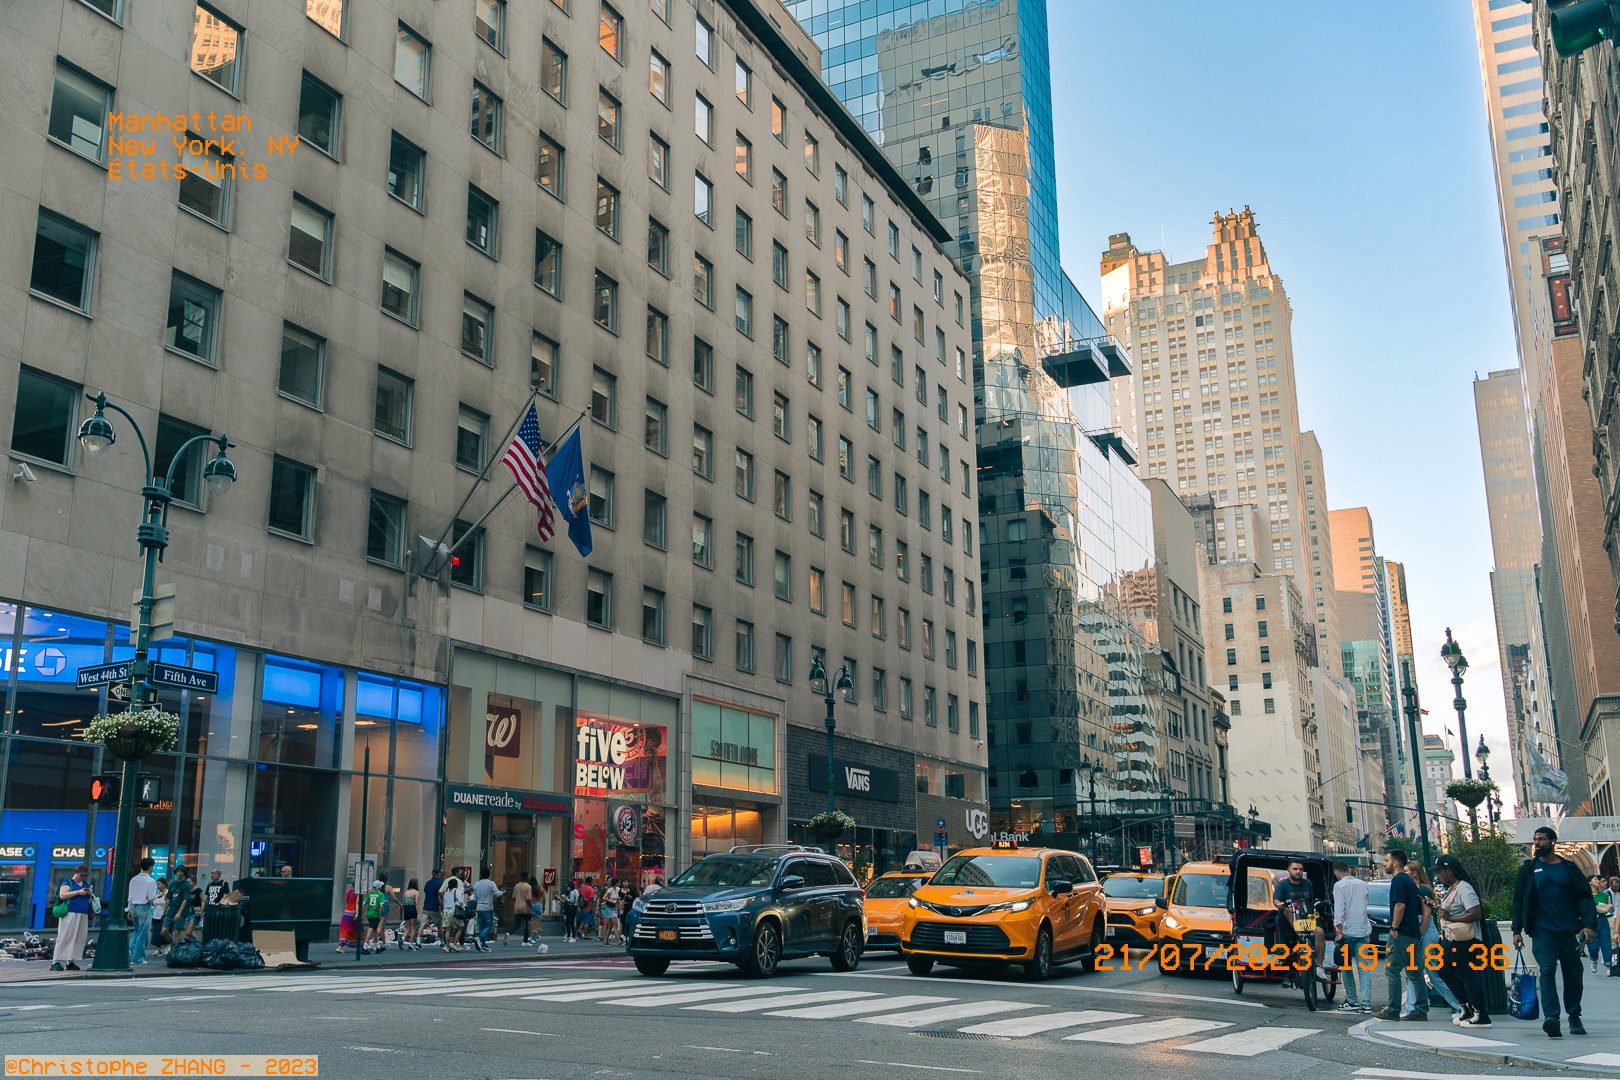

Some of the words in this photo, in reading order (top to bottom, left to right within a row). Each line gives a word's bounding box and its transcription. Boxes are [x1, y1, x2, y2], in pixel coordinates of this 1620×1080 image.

[0, 648, 28, 673] E
[80, 673, 99, 684] West
[100, 670, 117, 681] 44th
[118, 667, 128, 678] St
[164, 669, 187, 684] Fifth
[188, 674, 207, 687] Ave
[116, 687, 131, 697] ONE
[577, 726, 627, 765] five
[844, 766, 870, 792] VANS
[515, 800, 522, 810] by
[965, 809, 989, 840] UGG
[1000, 831, 1030, 842] Bank
[53, 848, 85, 858] CHAS
[208, 885, 222, 893] JUST
